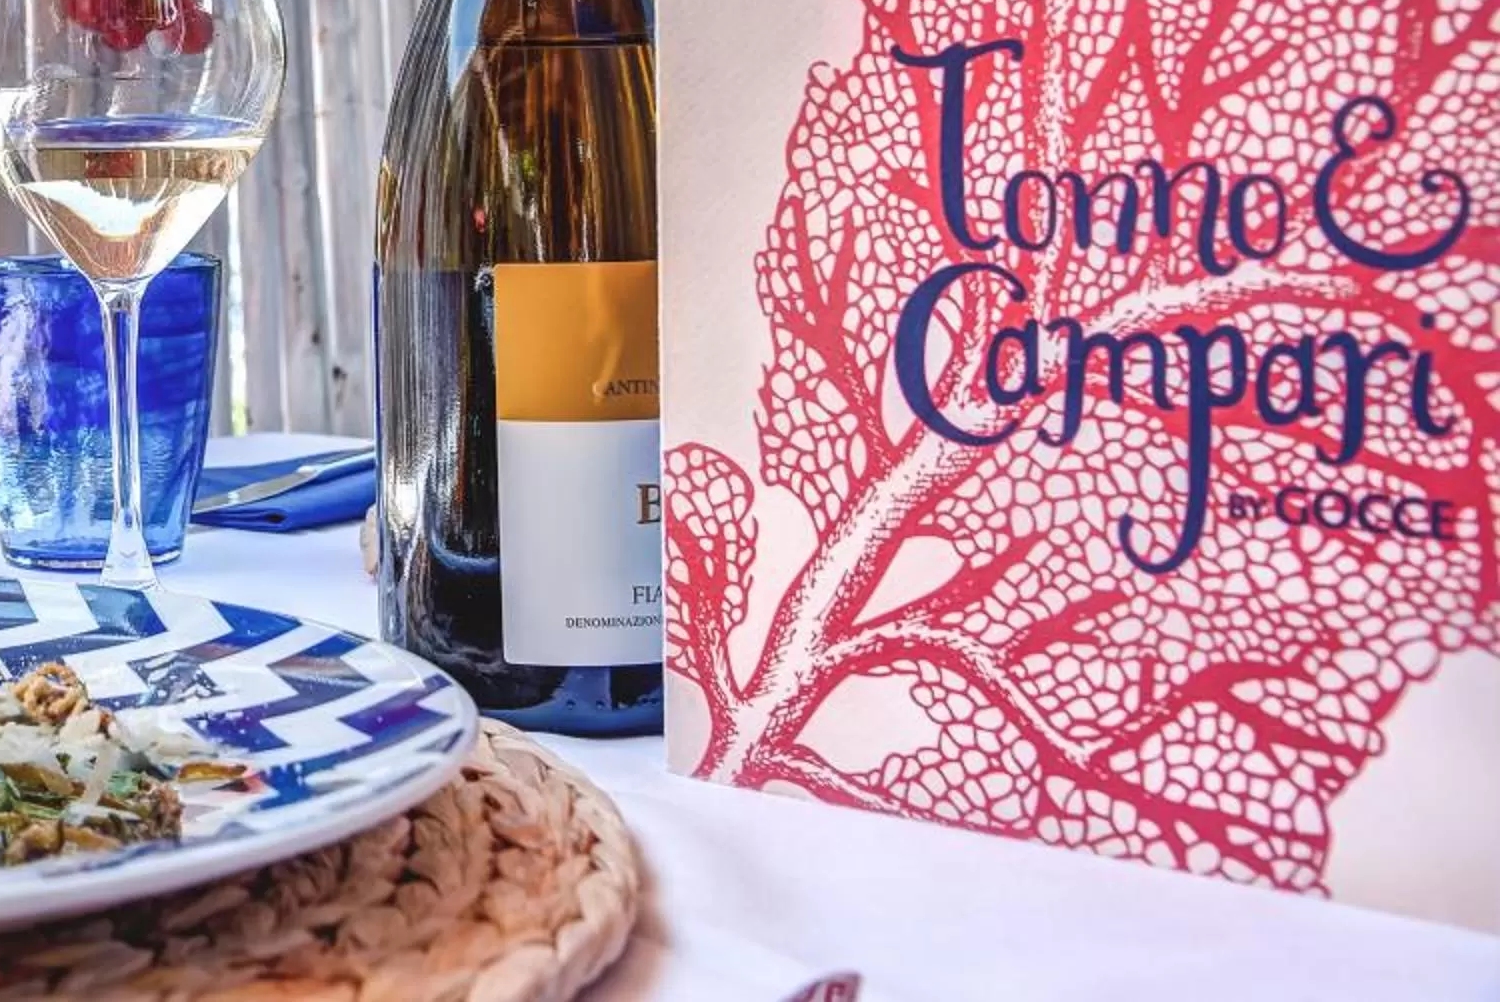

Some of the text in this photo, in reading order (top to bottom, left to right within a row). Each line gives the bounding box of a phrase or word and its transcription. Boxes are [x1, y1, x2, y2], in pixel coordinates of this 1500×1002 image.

[891, 40, 1470, 276] Tonno &
[894, 262, 1455, 575] Campari
[1229, 486, 1457, 541] BY GOCCE
